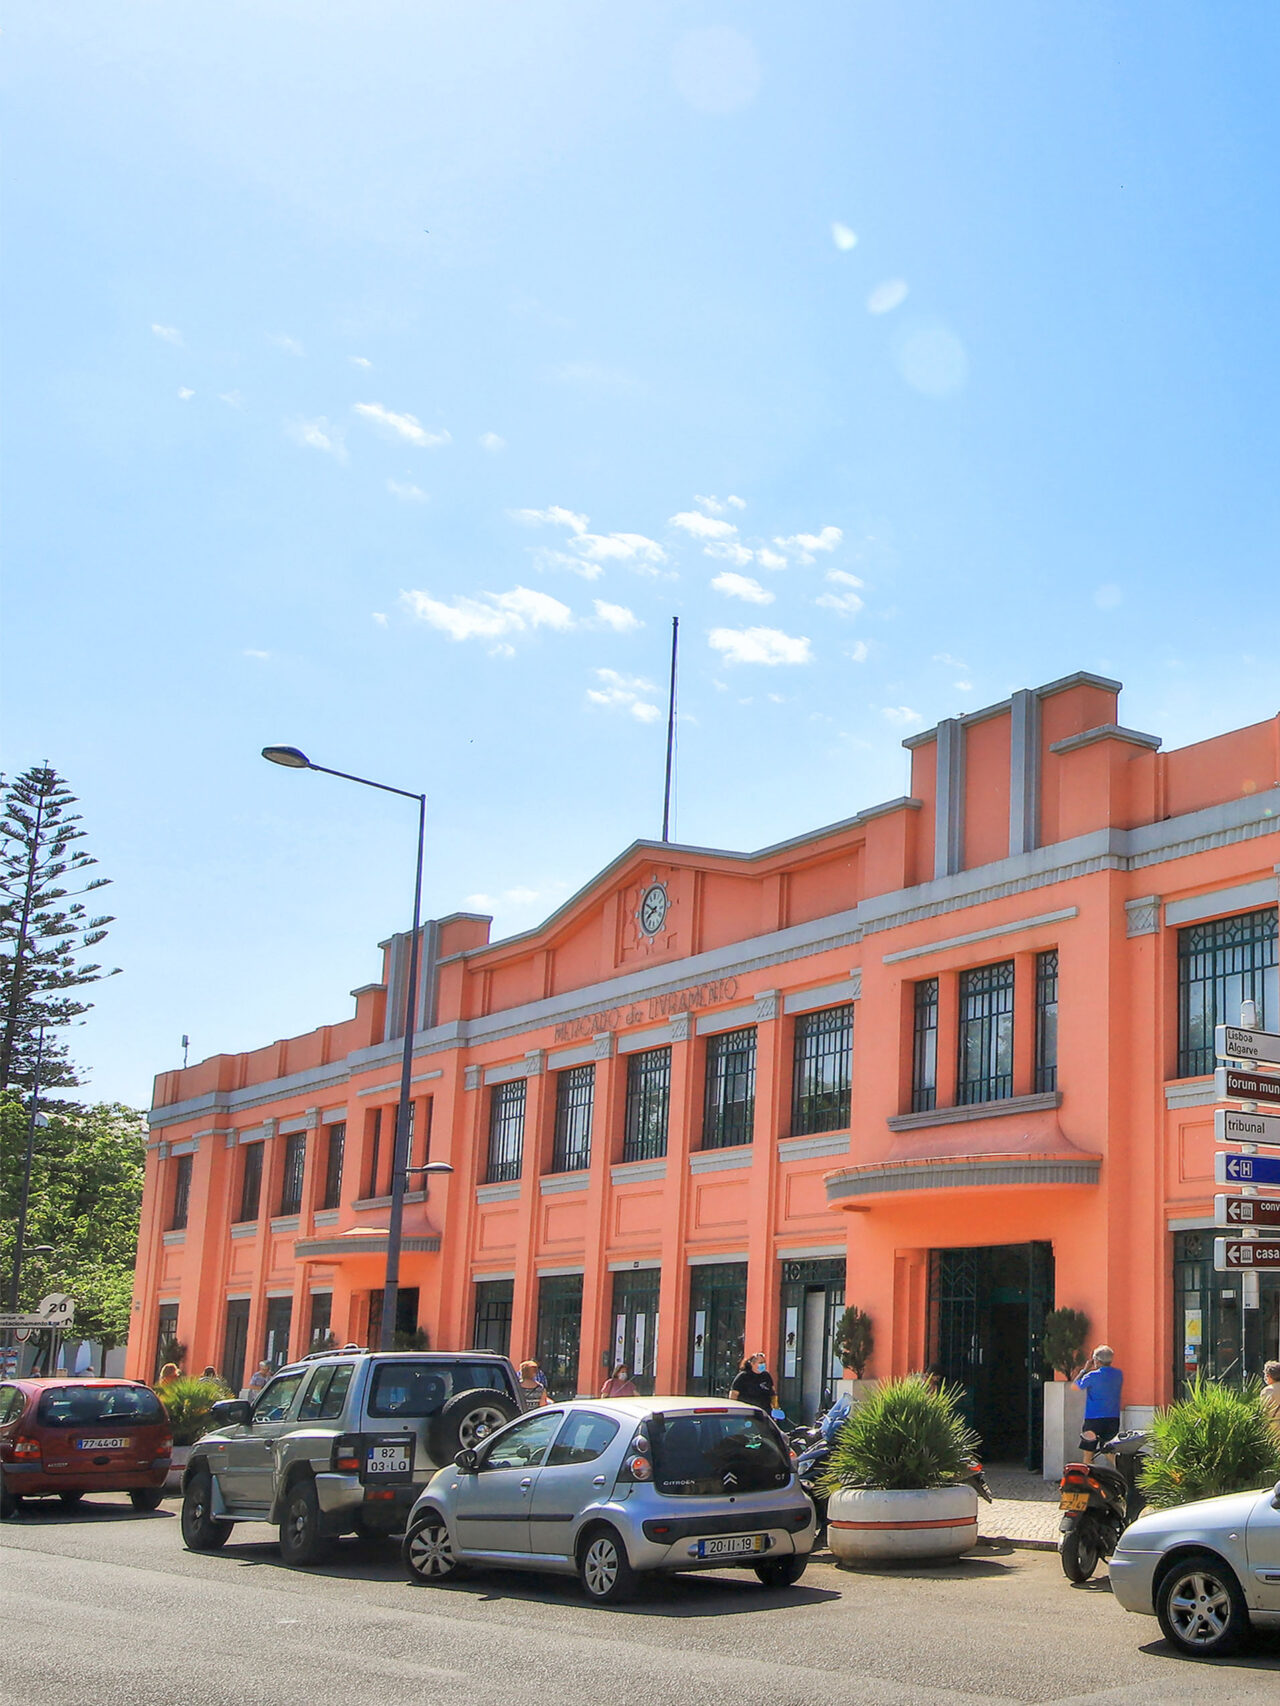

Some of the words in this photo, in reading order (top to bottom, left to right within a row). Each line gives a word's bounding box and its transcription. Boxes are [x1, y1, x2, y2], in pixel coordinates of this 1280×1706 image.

[1228, 1030, 1253, 1042] Lisboa
[1228, 1042, 1258, 1055] Algarve
[1228, 1075, 1257, 1091] forum
[1228, 1119, 1265, 1134] tribunal
[1256, 1249, 1280, 1259] casa
[48, 1303, 67, 1313] 20
[381, 1448, 396, 1458] 82
